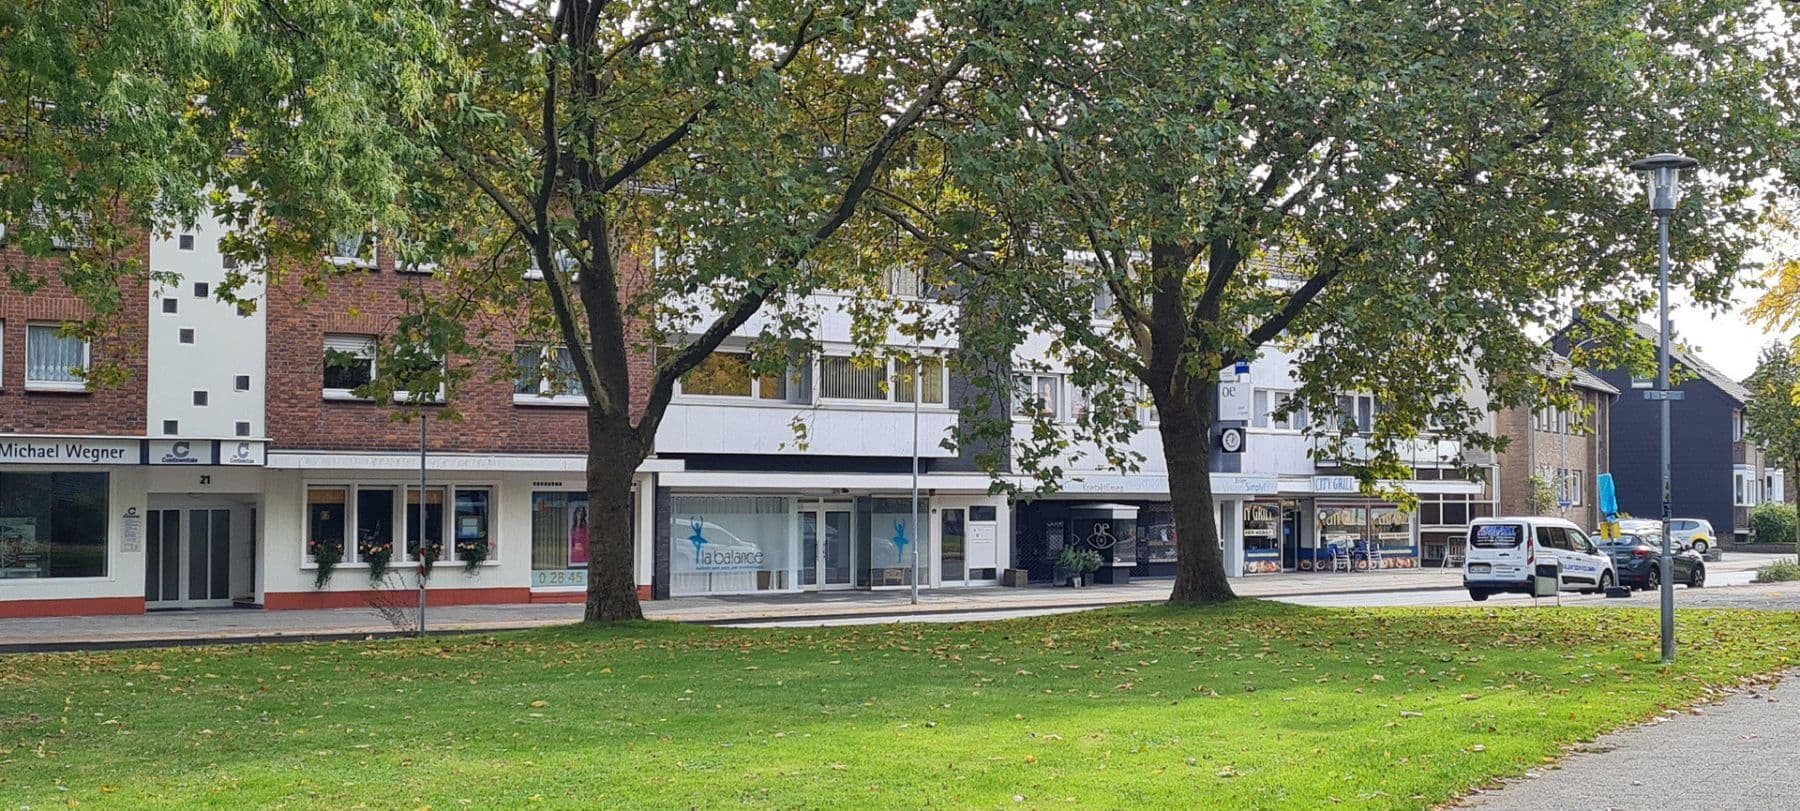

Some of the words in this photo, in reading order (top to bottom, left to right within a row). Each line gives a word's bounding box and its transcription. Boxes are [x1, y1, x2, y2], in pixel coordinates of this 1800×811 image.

[0, 443, 59, 459] Michael
[65, 443, 125, 463] Wegner
[199, 475, 210, 485] 21
[1315, 477, 1330, 491] CITY
[1333, 477, 1354, 490] GRILL
[1253, 505, 1273, 521] GRILL
[701, 550, 711, 565] la
[714, 549, 764, 565] balance
